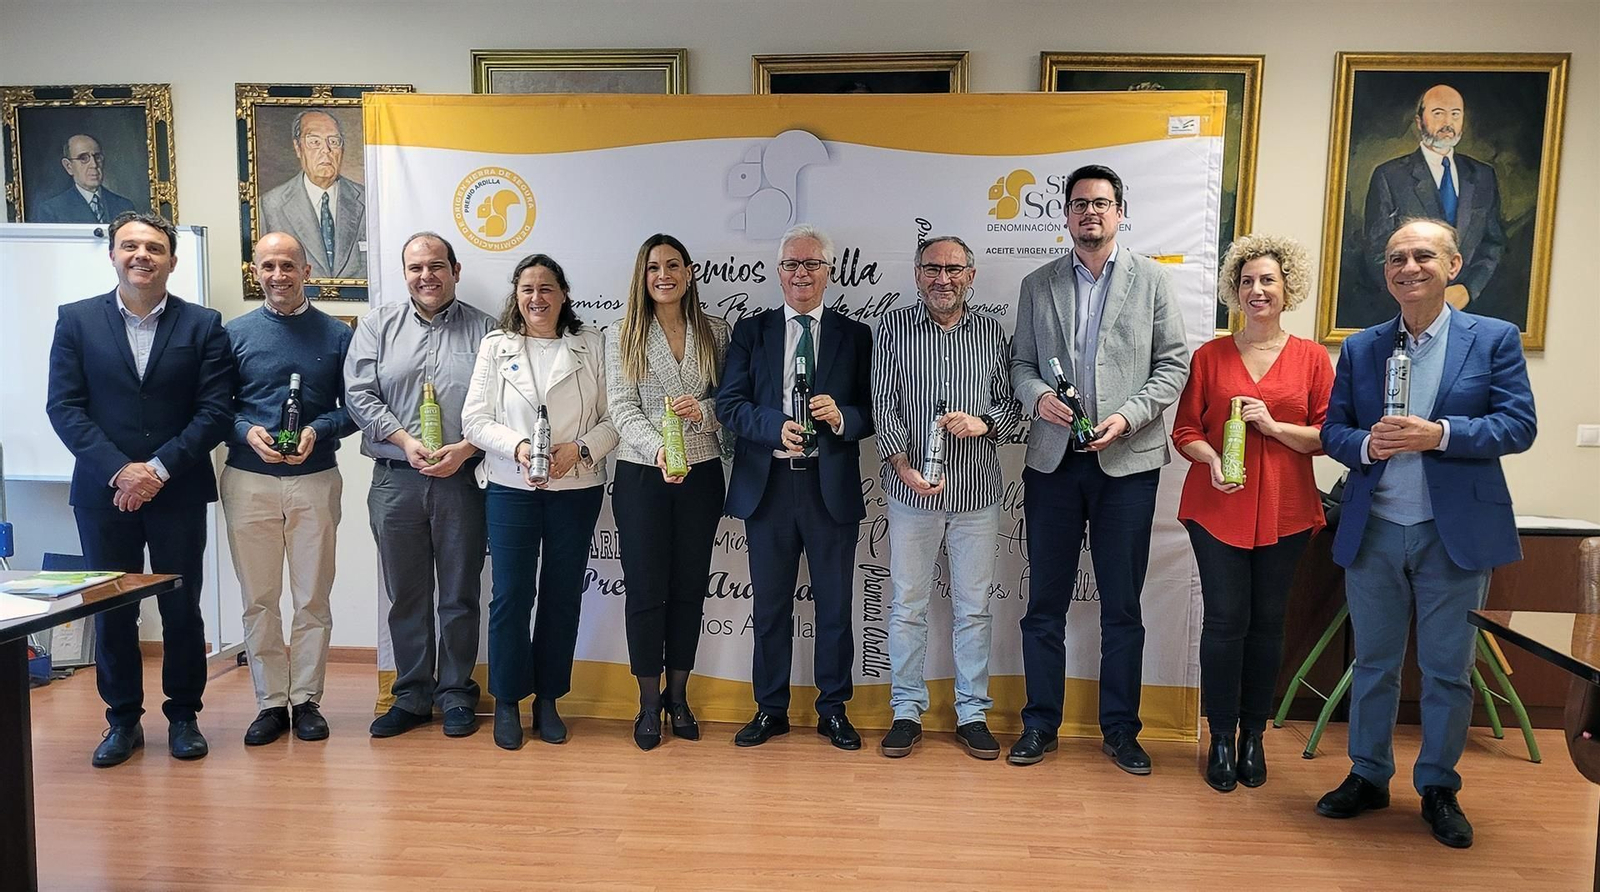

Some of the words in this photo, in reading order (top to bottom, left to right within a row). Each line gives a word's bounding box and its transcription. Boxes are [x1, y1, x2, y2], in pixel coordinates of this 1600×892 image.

[455, 185, 467, 218] ORIGEN
[466, 169, 495, 184] SIERRA
[499, 170, 511, 178] DE
[512, 176, 534, 208] SEGURA
[464, 188, 476, 213] PREMIO
[474, 179, 501, 191] ARDILLA
[987, 222, 1061, 232] DENOMINACIÓN
[692, 256, 766, 284] emios
[829, 247, 883, 287] illa
[571, 294, 625, 310] mios
[829, 292, 901, 323] Ardill
[858, 563, 893, 622] Premios
